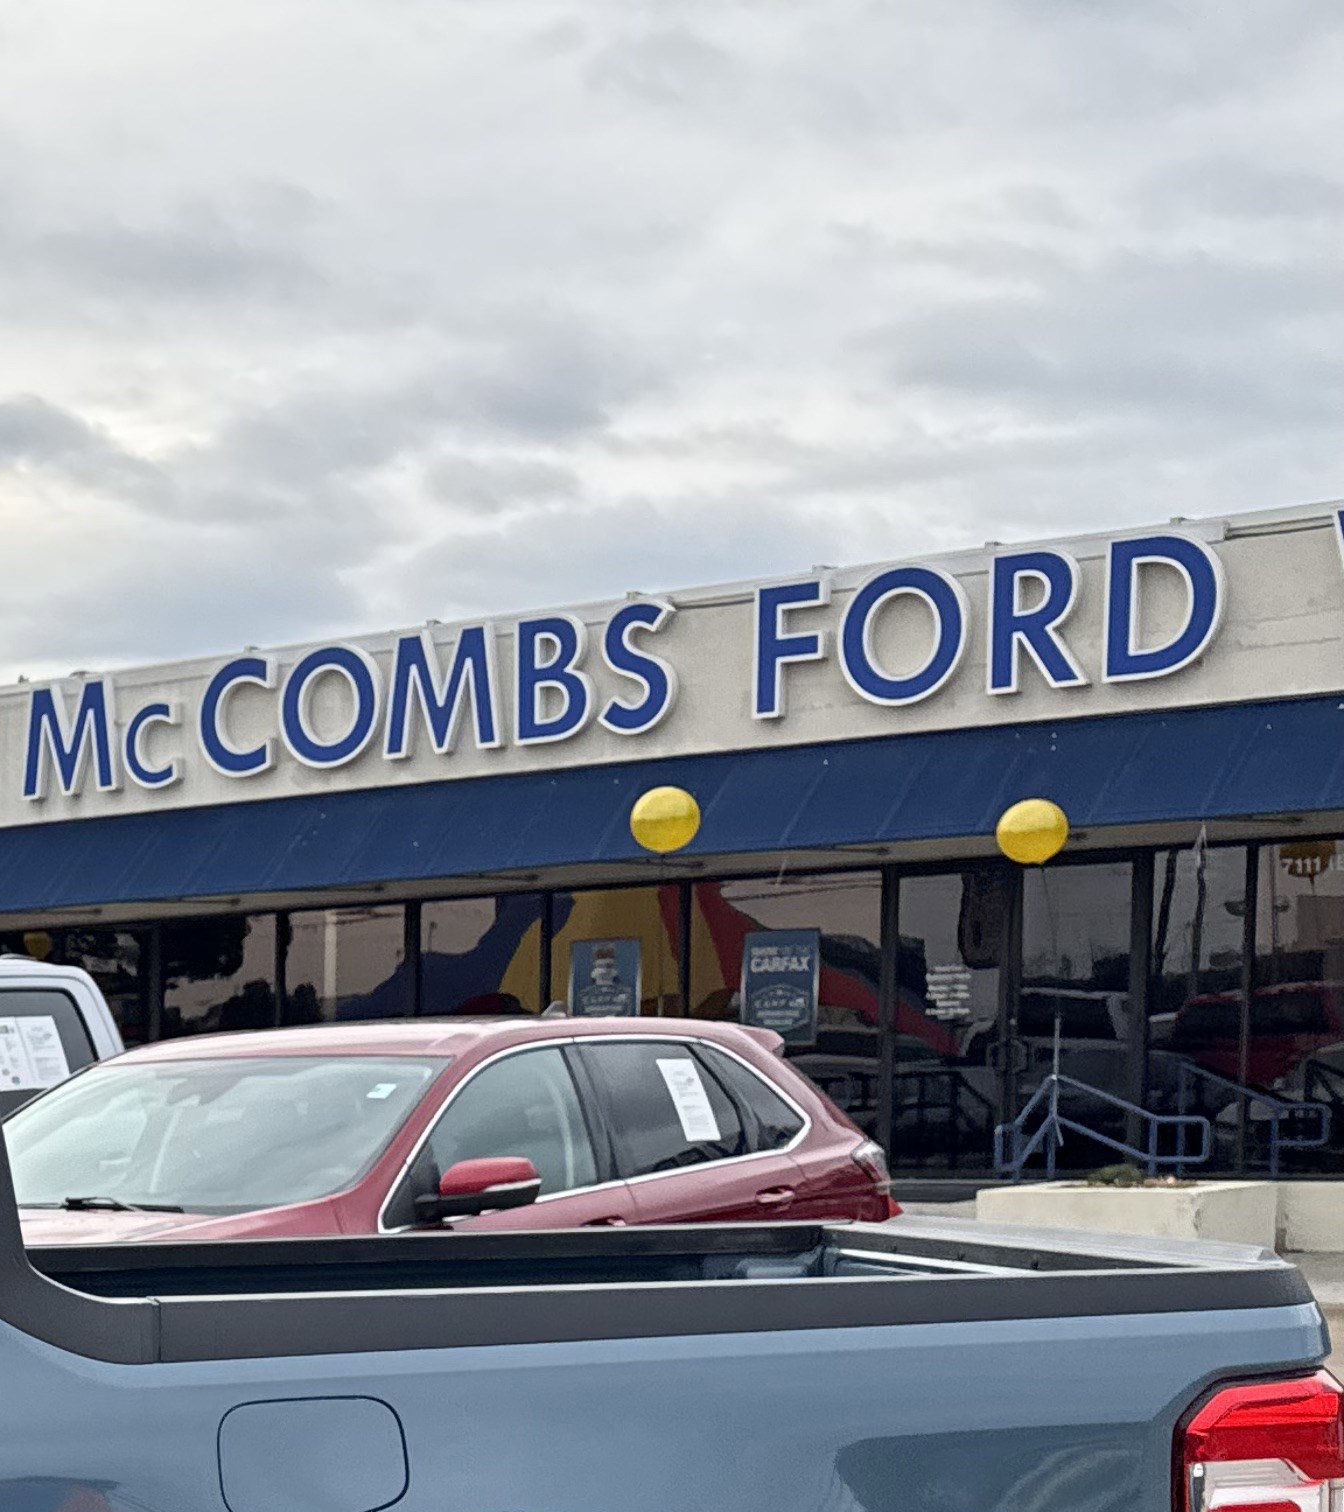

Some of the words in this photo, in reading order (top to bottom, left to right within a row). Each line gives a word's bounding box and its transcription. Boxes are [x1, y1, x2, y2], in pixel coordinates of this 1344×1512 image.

[21, 596, 678, 801] McCOMBS
[752, 532, 1228, 720] FORD
[1280, 856, 1322, 874] 7111
[749, 956, 811, 974] CARFAX
